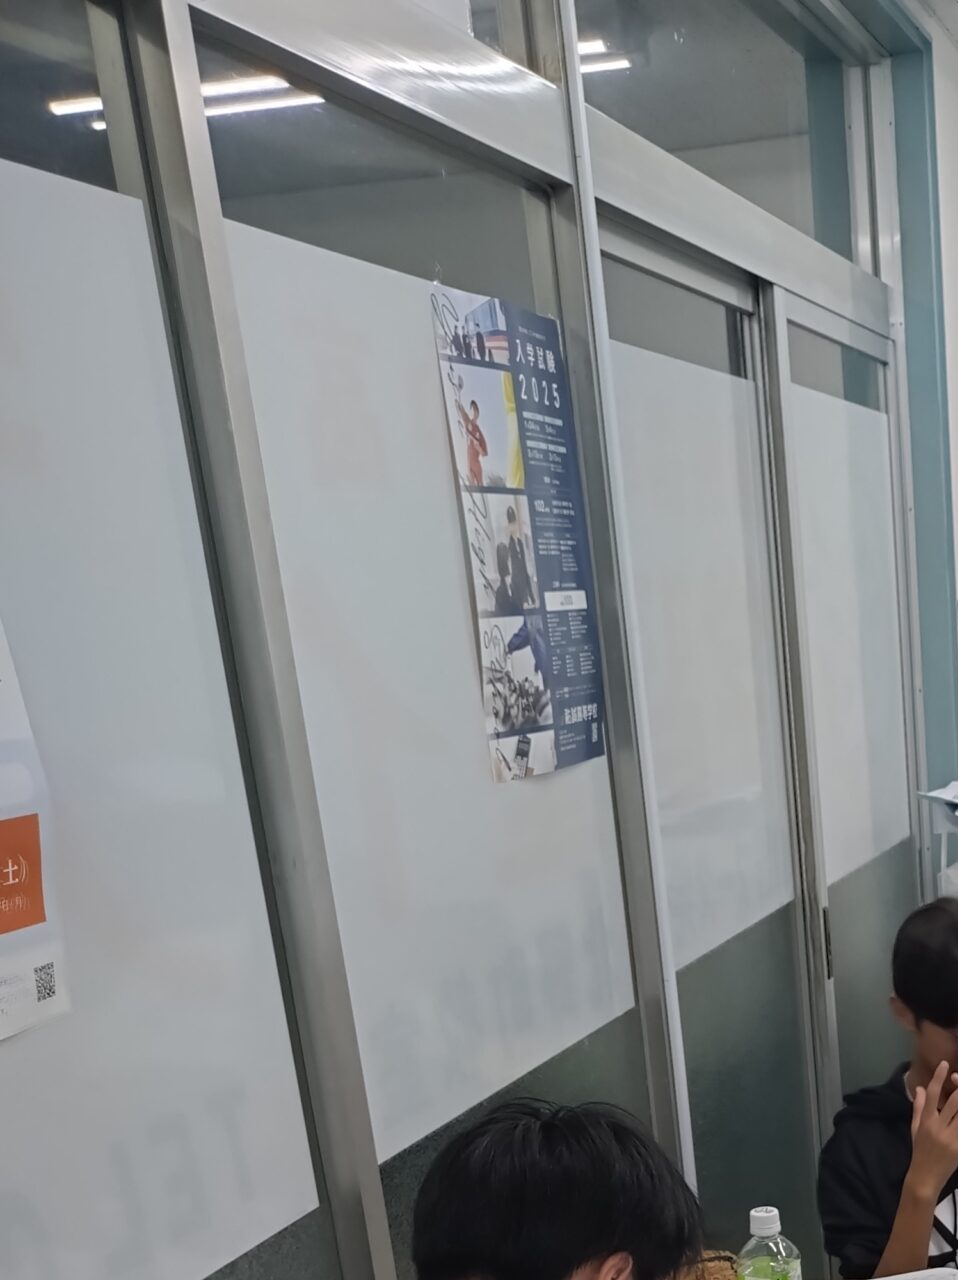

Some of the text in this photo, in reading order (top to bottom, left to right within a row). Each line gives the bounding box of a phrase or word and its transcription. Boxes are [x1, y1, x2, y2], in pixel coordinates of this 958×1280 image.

[515, 339, 556, 375] 入学試験
[519, 373, 560, 409] 2025
